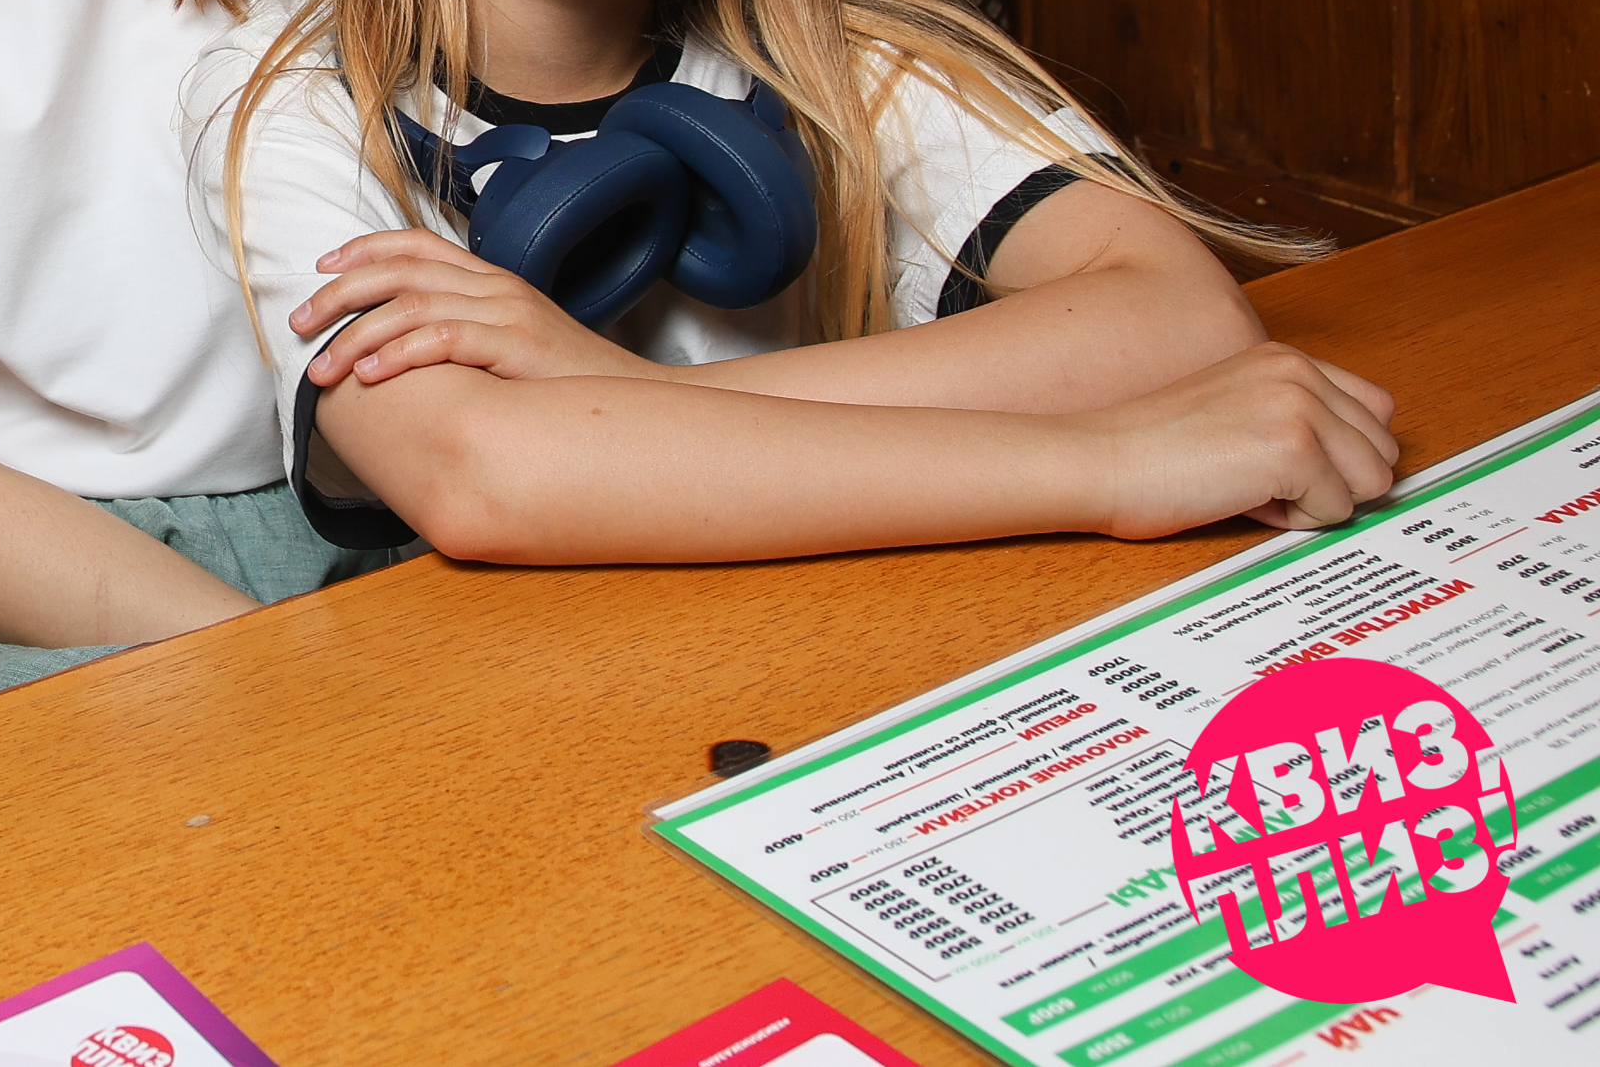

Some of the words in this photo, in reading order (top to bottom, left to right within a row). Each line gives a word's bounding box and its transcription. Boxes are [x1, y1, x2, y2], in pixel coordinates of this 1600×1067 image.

[1534, 488, 1600, 523] КИЛА
[1330, 579, 1475, 646] ИГРИСТЫЕ
[1089, 657, 1129, 677] 1700₽
[1105, 664, 1147, 685] 1900₽
[1122, 672, 1161, 693] 4100₽
[1139, 680, 1178, 701] 4100₽
[1156, 687, 1201, 710] 3800₽
[1017, 703, 1097, 740] ФРЕШИ
[1028, 726, 1149, 783] МОЛОЧНЫЕ
[1086, 775, 1120, 791] Микс
[1106, 769, 1194, 811] иви-Виноград
[914, 780, 1032, 834] КОКТЕЙЛИ
[904, 857, 942, 877] 270₽
[1107, 810, 1295, 907] ЛИМАДЫ
[811, 862, 849, 882] 450₽
[919, 866, 957, 887] 270₽
[850, 880, 890, 901] 590₽
[934, 875, 972, 895] 270₽
[949, 884, 987, 905] 270₽
[865, 890, 905, 911] 590₽
[880, 899, 920, 920] 590₽
[964, 893, 1003, 914] 270₽
[894, 908, 935, 929] 590₽
[980, 903, 1018, 924] 270₽
[996, 912, 1035, 934] 270₽
[909, 917, 950, 939] 590₽
[925, 927, 966, 949] 590₽
[941, 937, 982, 959] 590₽
[1317, 1007, 1401, 1049] ЧАЙ
